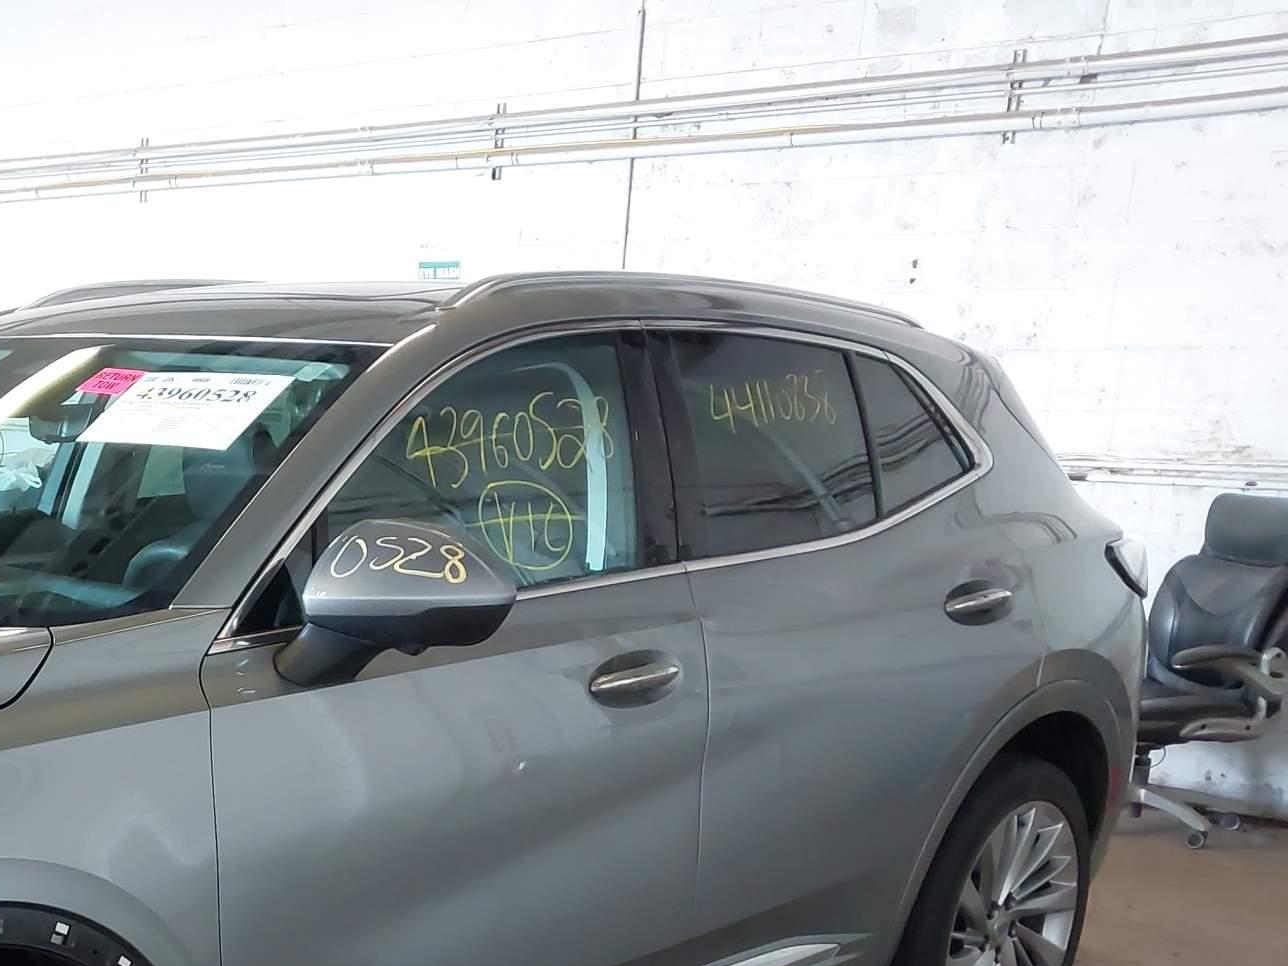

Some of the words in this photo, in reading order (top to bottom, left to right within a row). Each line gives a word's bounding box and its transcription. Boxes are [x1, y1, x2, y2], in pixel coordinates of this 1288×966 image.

[95, 371, 141, 382] RETURN
[92, 380, 120, 390] TOW
[136, 387, 257, 403] 43960528
[406, 391, 614, 489] 43960528
[330, 535, 468, 584] 0528
